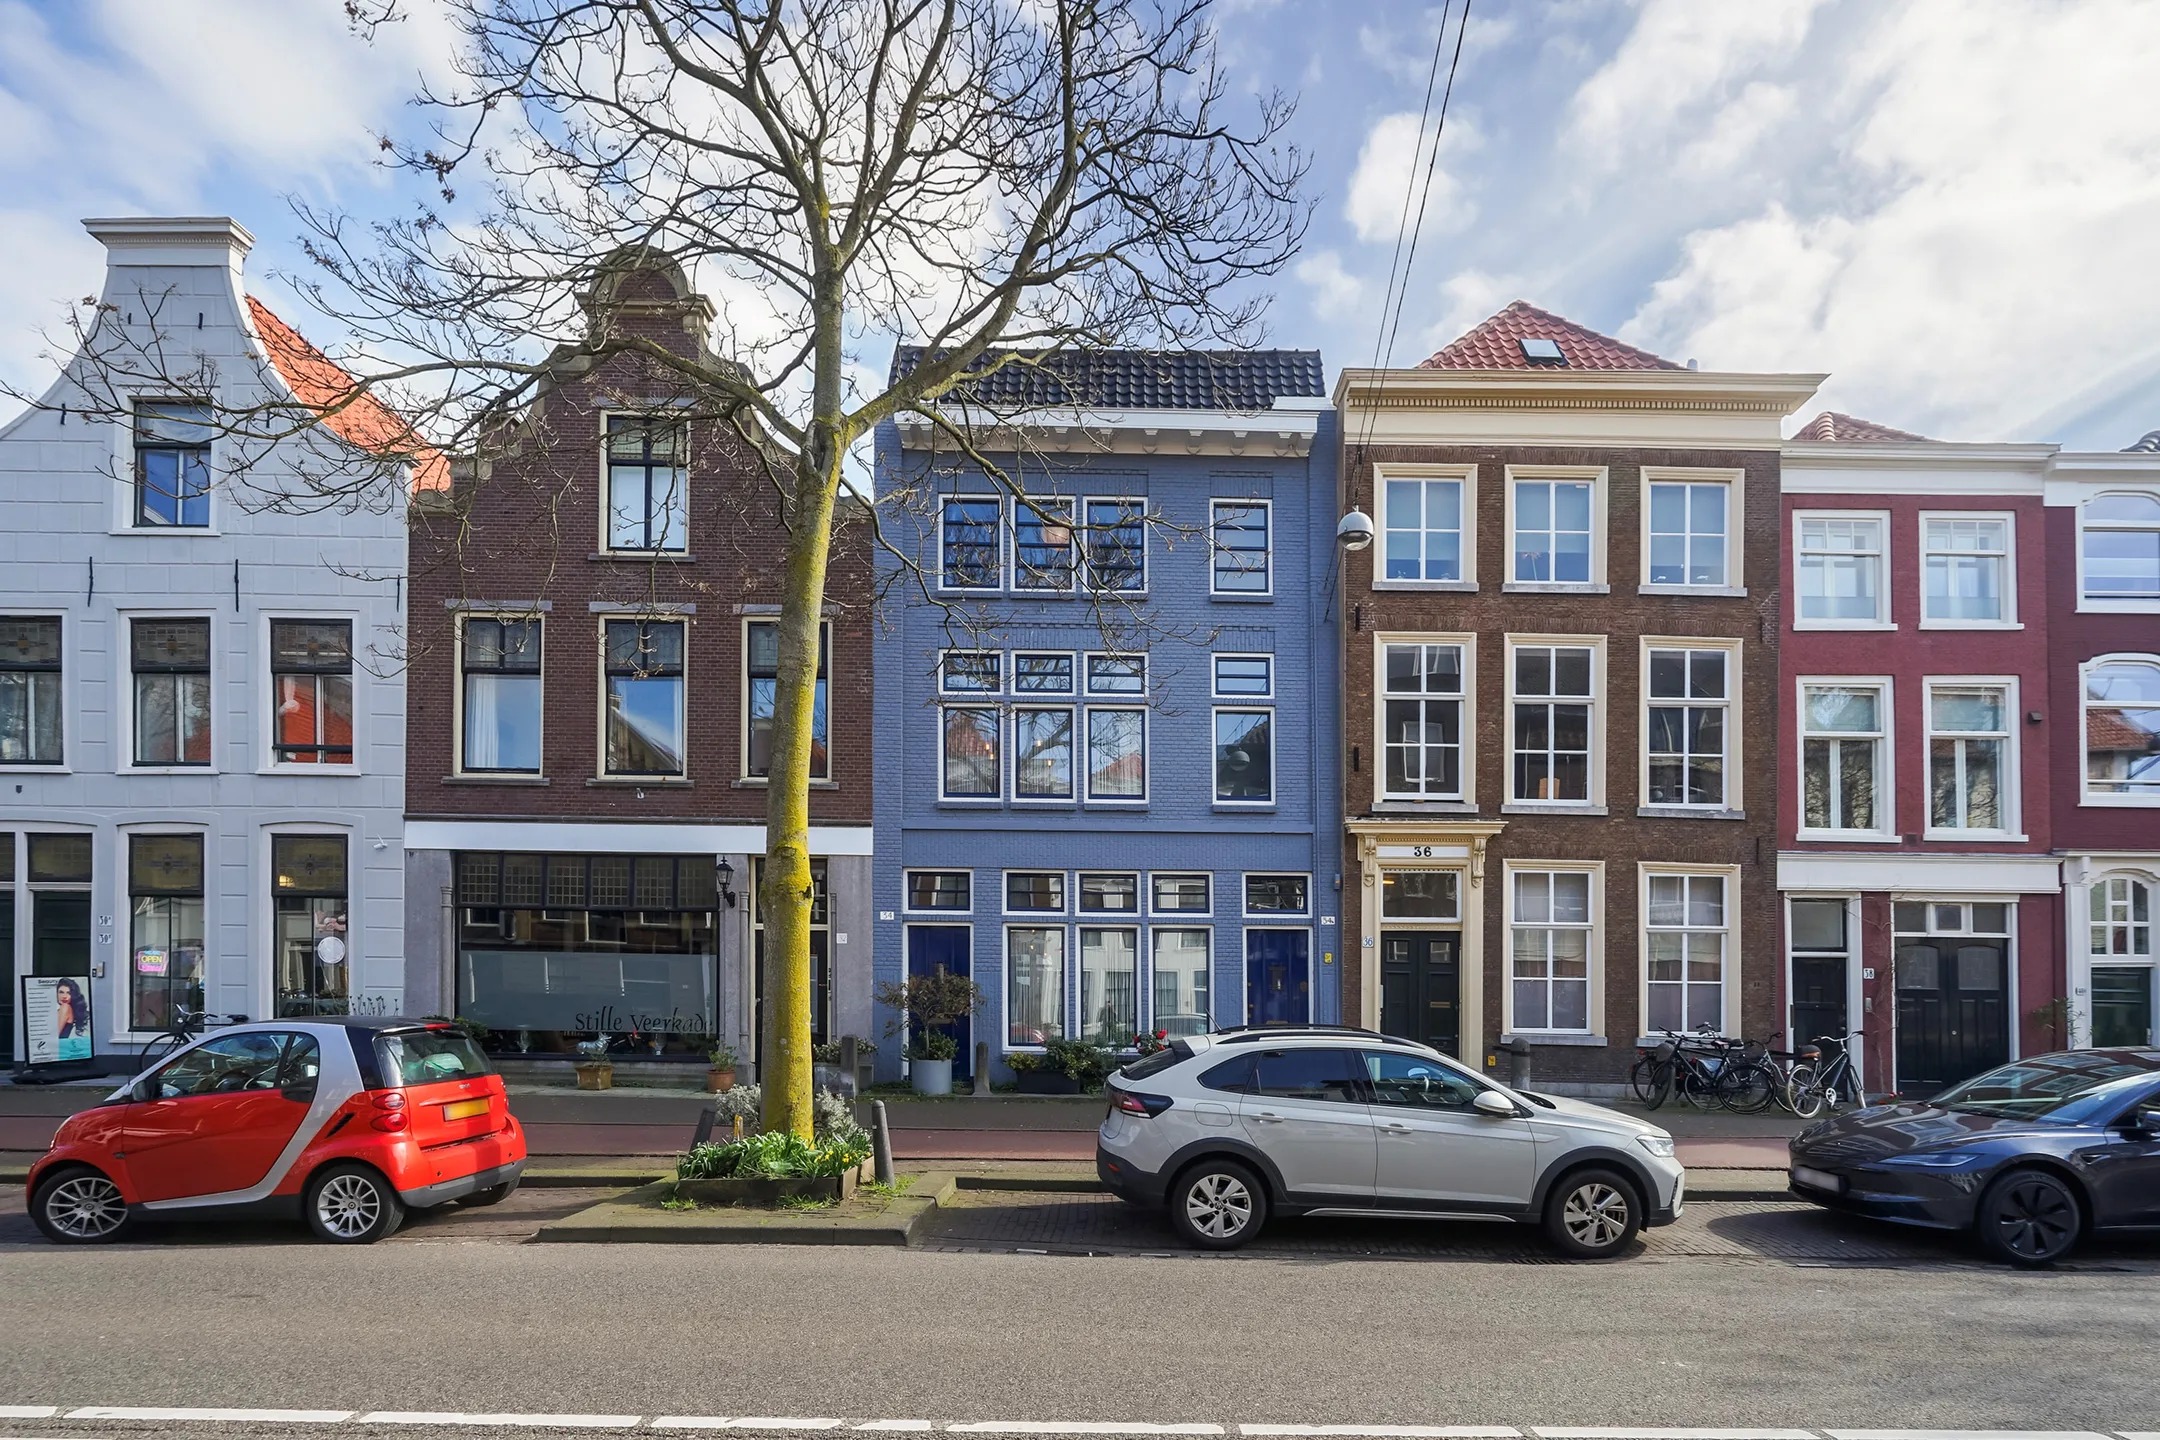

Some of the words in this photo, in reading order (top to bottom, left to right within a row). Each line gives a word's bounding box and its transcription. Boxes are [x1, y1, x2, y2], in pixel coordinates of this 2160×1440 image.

[1414, 846, 1432, 857] 36
[1364, 936, 1373, 946] 36
[141, 955, 163, 963] OPEN
[575, 1006, 623, 1031] Stille
[630, 1007, 713, 1032] Veerkade
